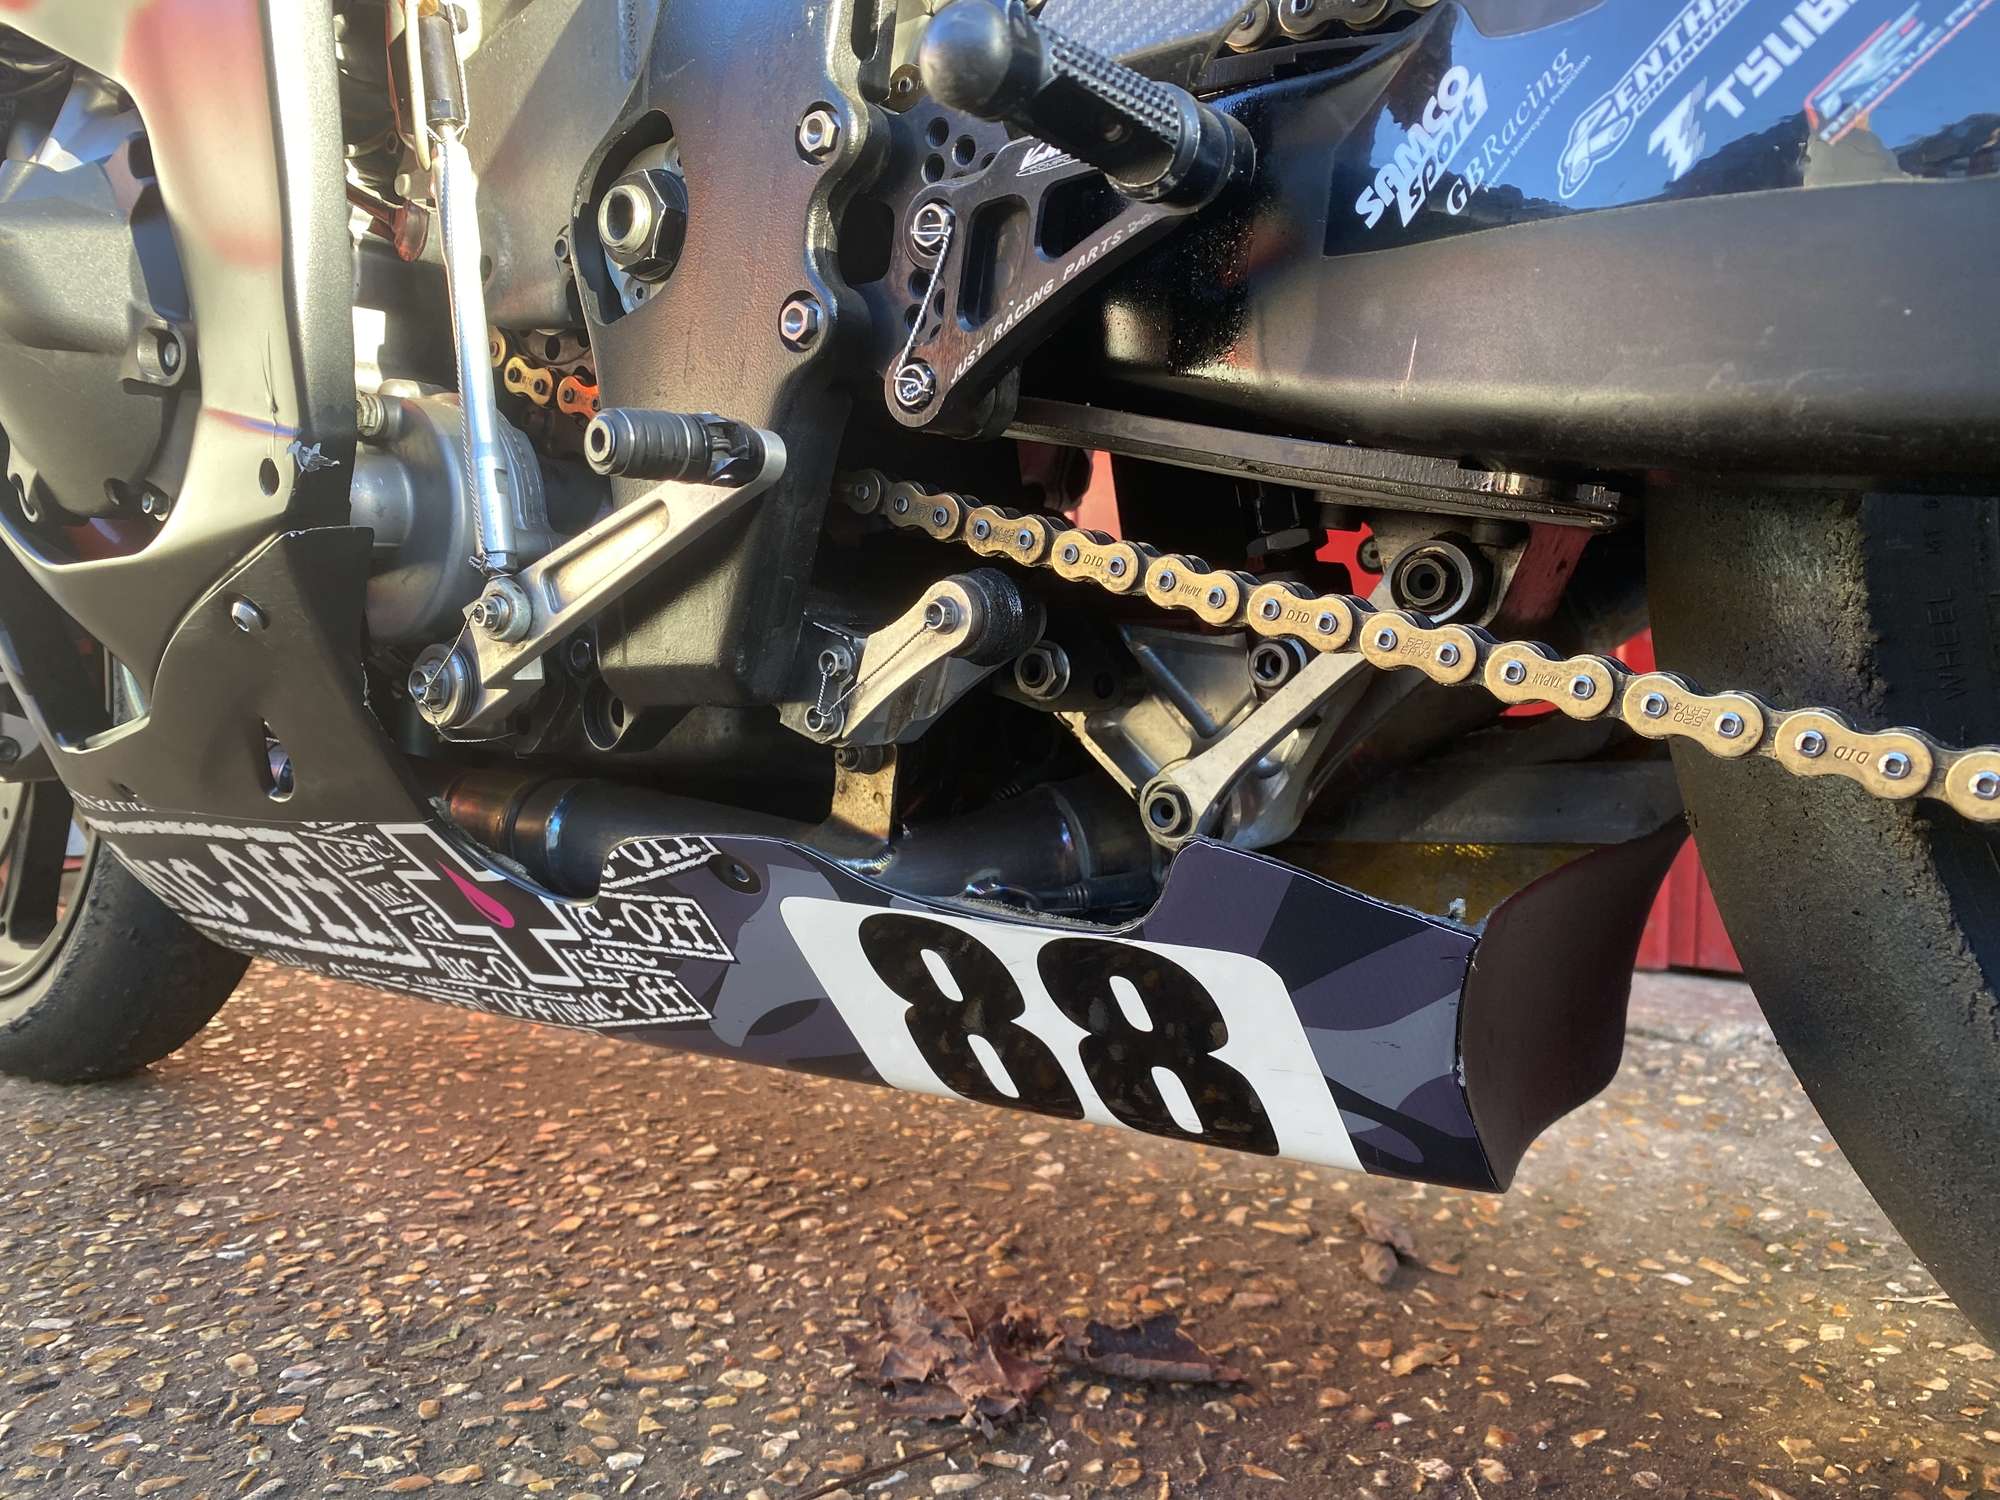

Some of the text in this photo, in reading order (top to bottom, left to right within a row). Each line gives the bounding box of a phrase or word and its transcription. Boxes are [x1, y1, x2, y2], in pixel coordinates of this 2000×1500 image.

[1355, 65, 1470, 229] SAMCO
[950, 229, 1123, 384] JUST RACING PARTS
[1082, 554, 1104, 568] DID
[1178, 582, 1202, 598] JAPAN
[1285, 609, 1311, 625] DID
[1532, 672, 1563, 689] JAPAN
[1673, 711, 1703, 728] 520
[1833, 744, 1870, 765] DID
[858, 912, 1280, 1157] 88
